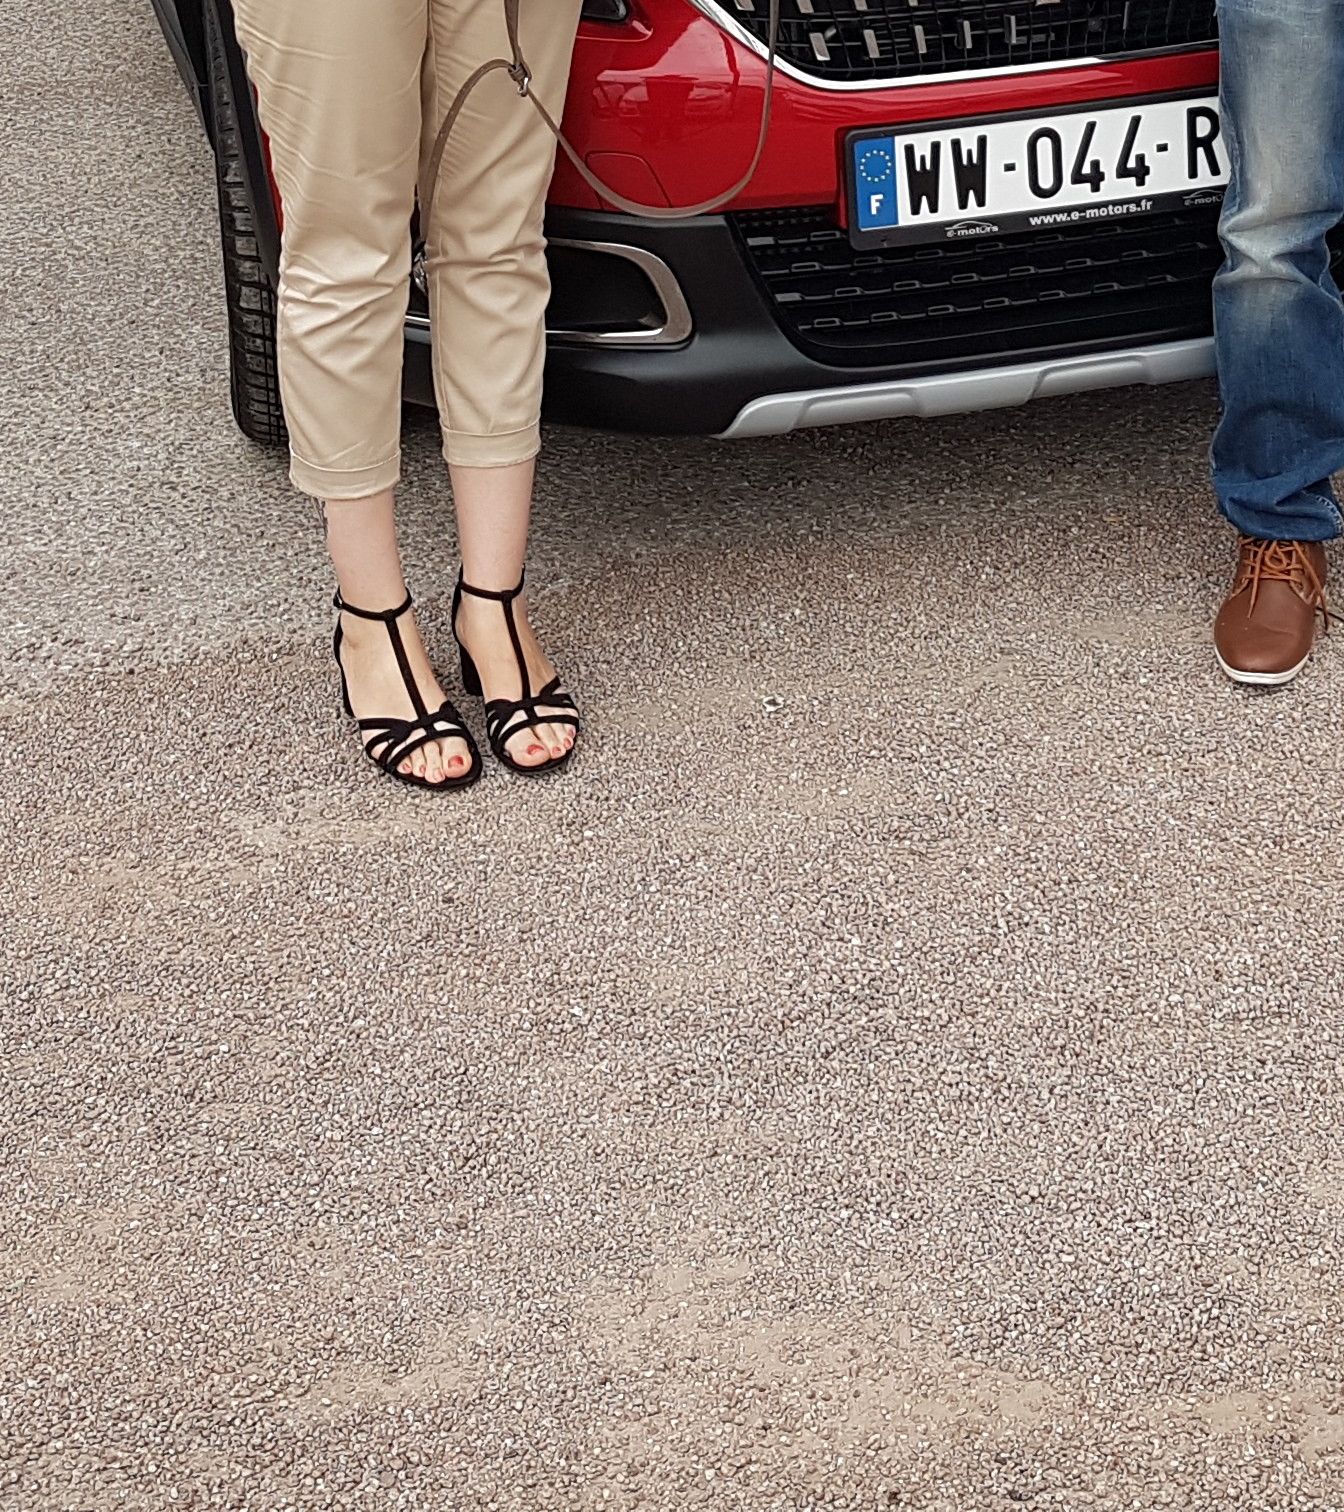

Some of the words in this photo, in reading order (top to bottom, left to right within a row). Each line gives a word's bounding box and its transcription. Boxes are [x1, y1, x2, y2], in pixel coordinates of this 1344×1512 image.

[903, 106, 1222, 216] WW-044-R
[870, 194, 884, 216] F
[1183, 193, 1224, 207] e-moto
[1029, 199, 1153, 227] www.e-motors.fr
